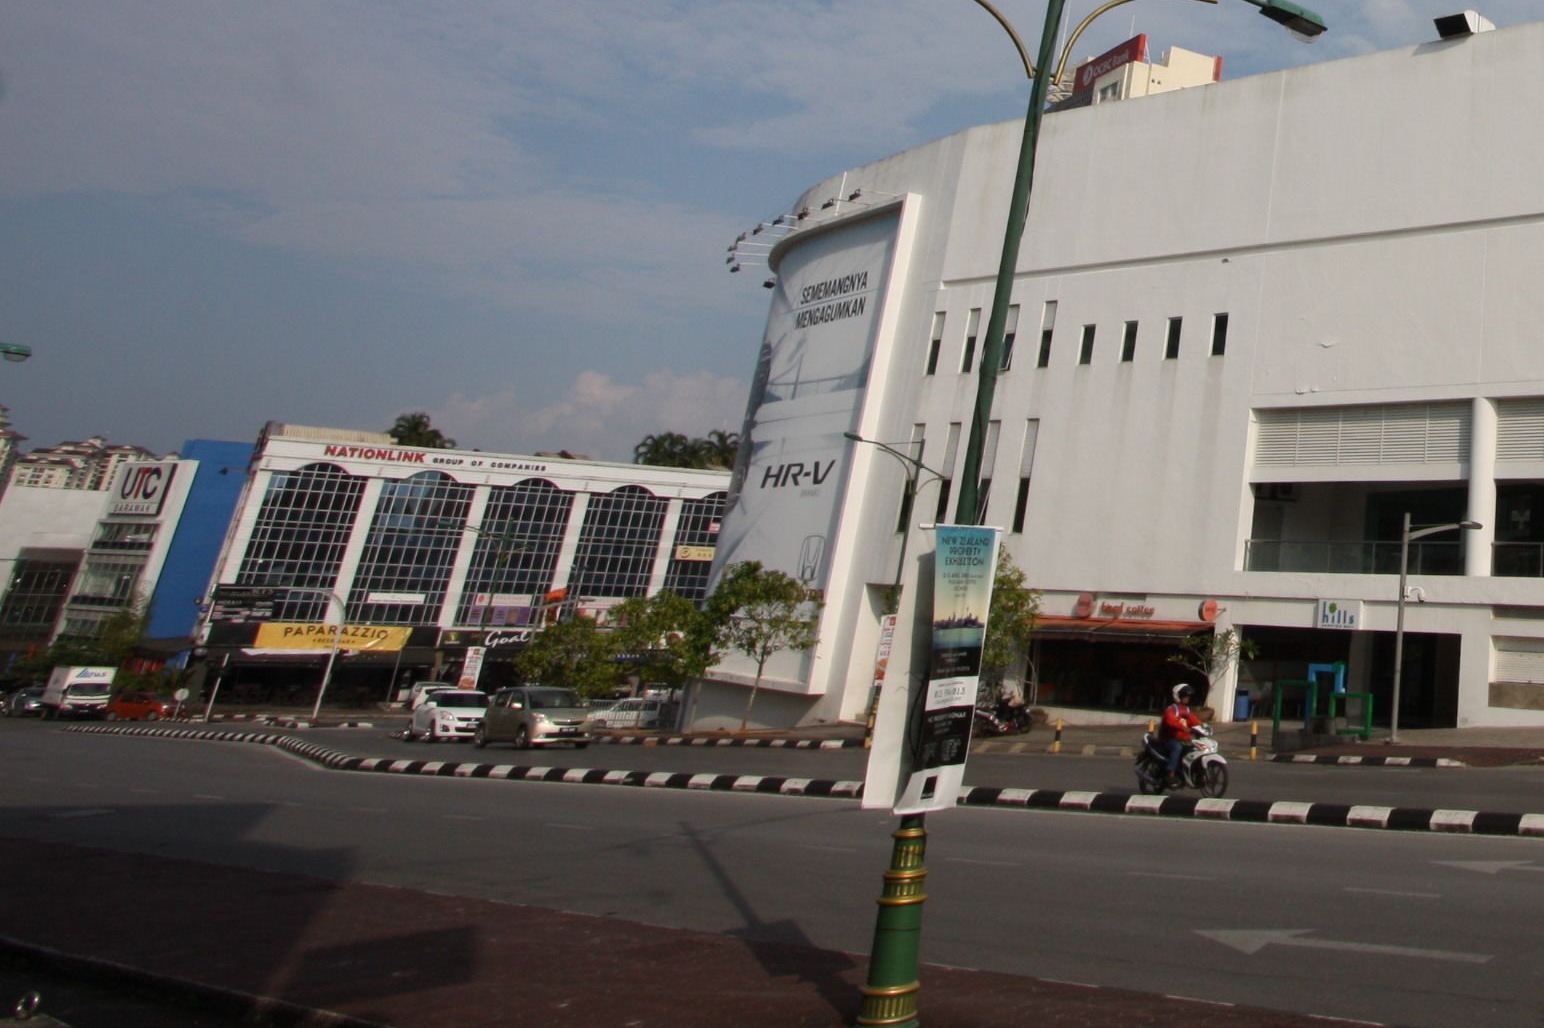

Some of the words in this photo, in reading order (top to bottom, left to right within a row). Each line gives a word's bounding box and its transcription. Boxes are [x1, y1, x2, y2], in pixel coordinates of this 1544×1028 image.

[801, 271, 868, 305] SEMEMANGNYA
[795, 297, 866, 330] MENGAGUMKAN
[324, 444, 426, 463] NATIONLINK
[433, 457, 464, 466] GROUP
[490, 461, 547, 472] COMPANIES
[121, 467, 162, 500] UTC
[760, 459, 836, 488] HR-V
[942, 536, 957, 545] NEW
[960, 536, 990, 546] ZEALAND
[1322, 601, 1354, 624] hills
[485, 630, 529, 648] Goal
